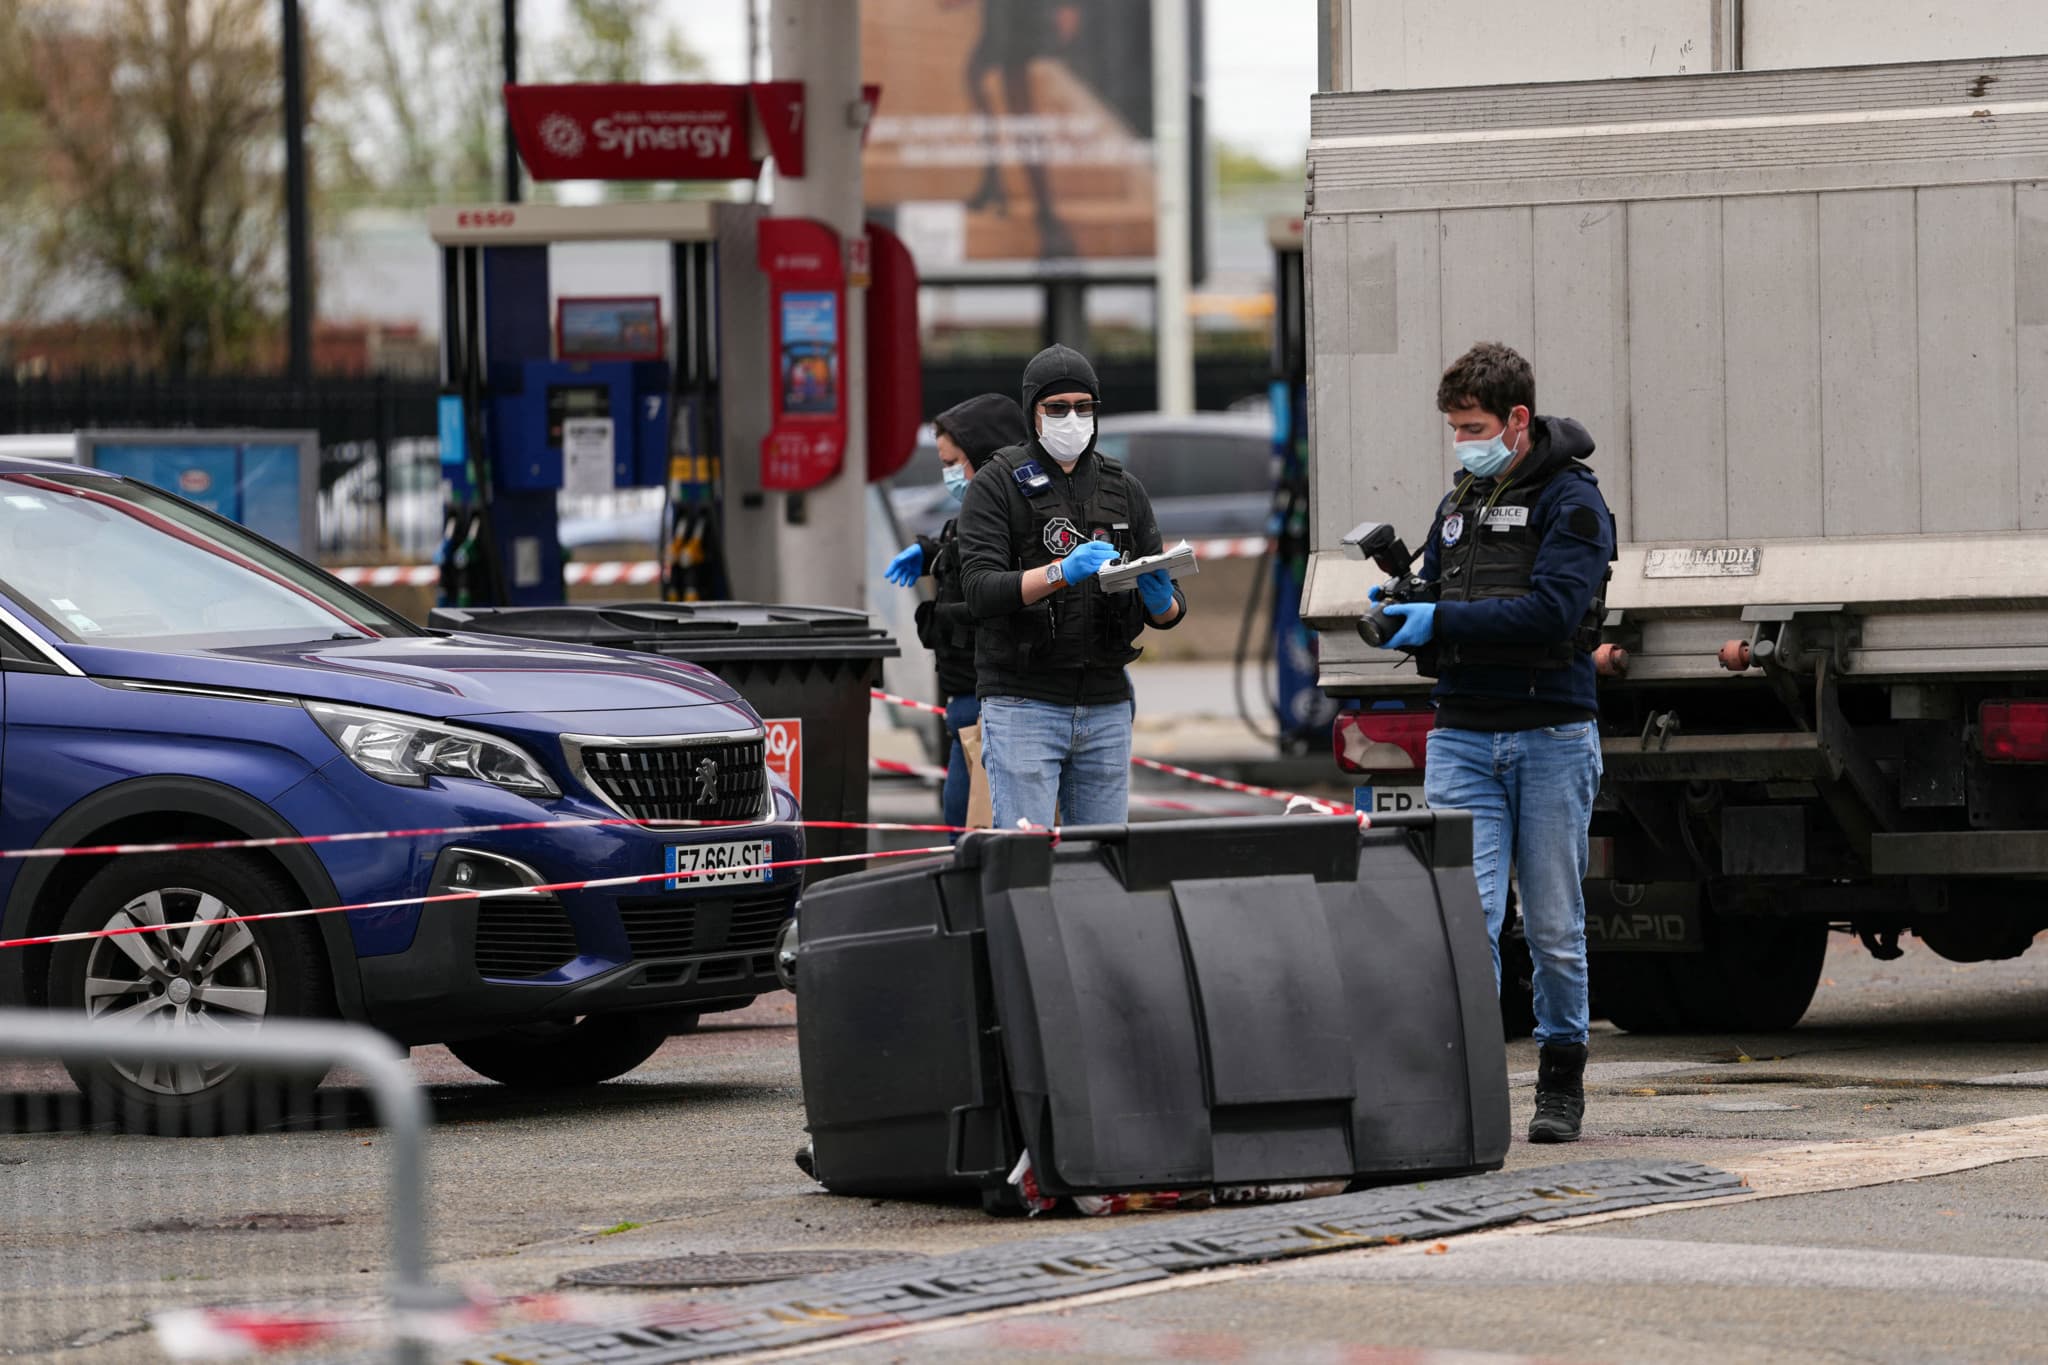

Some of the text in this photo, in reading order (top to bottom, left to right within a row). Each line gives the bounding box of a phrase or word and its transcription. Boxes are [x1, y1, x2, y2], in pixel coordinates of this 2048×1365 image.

[592, 118, 731, 158] Synergy
[646, 395, 663, 421] 7
[1487, 507, 1523, 518] OLICE
[678, 844, 762, 884] EZ-664-ST
